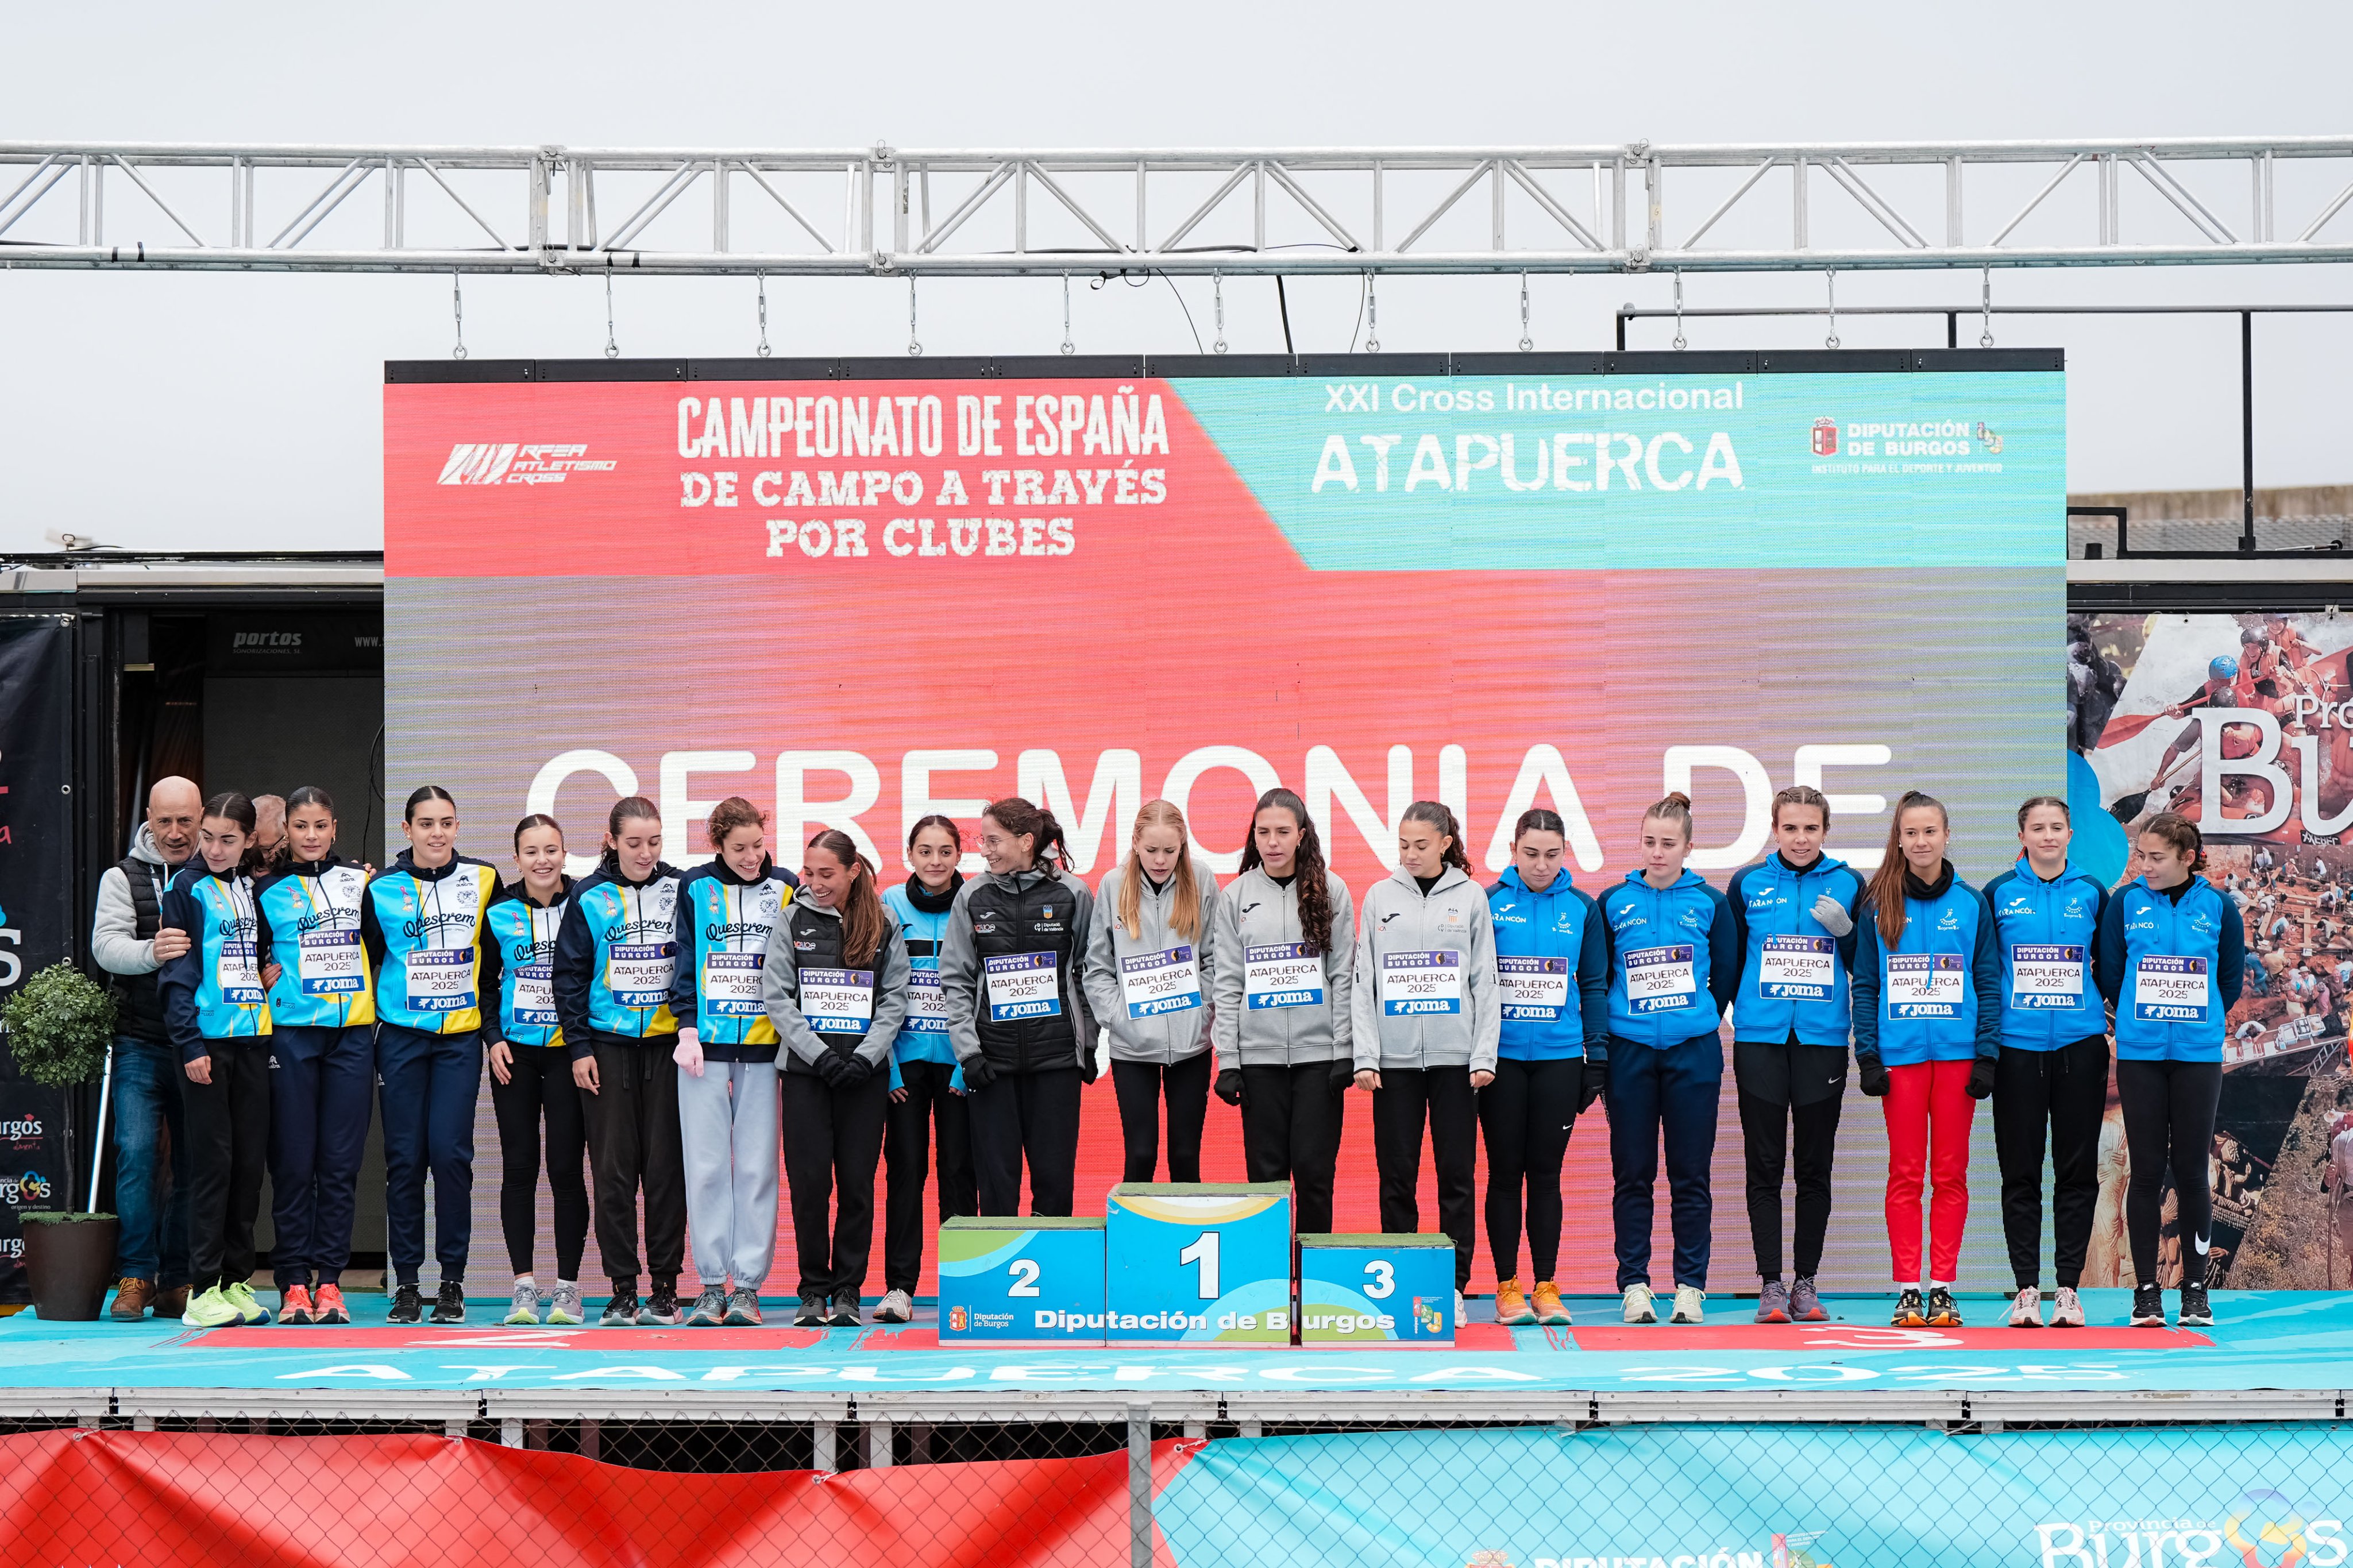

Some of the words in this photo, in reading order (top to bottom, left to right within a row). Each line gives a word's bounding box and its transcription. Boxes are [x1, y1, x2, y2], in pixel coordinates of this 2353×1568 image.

[1325, 384, 1378, 412] XXI
[1392, 383, 1494, 411] Cross
[1507, 382, 1743, 410] Internacional
[677, 395, 943, 458] CAMPEONATO
[957, 395, 1002, 455] DE
[1015, 385, 1170, 455] ESPAÑA
[1847, 419, 1969, 438] DIPUTACIÓN
[1847, 442, 1875, 455] DE
[1885, 441, 1970, 455] BURGOS
[514, 461, 617, 471] ATLETISMO
[1311, 432, 1745, 493] ATAPUERCA
[506, 473, 567, 484] CROSS
[681, 471, 738, 507] DE
[752, 470, 924, 507] CAMPO
[936, 470, 969, 505] A
[983, 459, 1167, 505] TRAVÉS
[766, 519, 869, 557] POR
[882, 517, 1075, 556] CLUBES
[233, 631, 302, 648] portos
[524, 743, 1605, 873] CEREMONIA
[1664, 744, 1893, 870] DE
[1749, 897, 1787, 907] TARANÓN
[298, 905, 360, 931] Quescrem
[403, 912, 476, 938] Quescrem
[304, 931, 345, 940] DIPUTACIÓN
[304, 937, 345, 945] BURGOS
[1249, 945, 1291, 954] DIPUTACIÓN
[1627, 949, 1666, 960] DIPUTACIÓN
[304, 952, 360, 963] ATAPUERCA
[989, 955, 1029, 966] DIPUTACIÓN
[1125, 952, 1166, 965] DIPUTACIÓN
[1249, 952, 1291, 960] BURGOS
[1388, 952, 1430, 961] DIPUTACIÓN
[1629, 955, 1666, 966] BURGOS
[325, 961, 350, 971] 2025
[989, 962, 1029, 971] BURGOS
[1126, 959, 1167, 971] BURGOS
[1765, 958, 1830, 968] ATAPUERCA
[614, 963, 673, 975] ATAPUERCA
[1250, 964, 1317, 977] ATAPUERCA
[1783, 968, 1812, 977] 2025
[2017, 968, 2080, 978] ATAPUERCA
[411, 970, 470, 980] ATAPUERCA
[633, 976, 661, 984] 2025
[1128, 968, 1192, 988] ATAPUERCA
[1270, 975, 1299, 986] 2025
[1387, 974, 1456, 983] ATAPUERCA
[1630, 969, 1689, 983] ATAPUERCA
[431, 982, 459, 990] 2025
[991, 975, 1054, 989] ATAPUERCA
[1149, 981, 1177, 994] 2025
[1499, 979, 1563, 990] ATAPUERCA
[1646, 980, 1675, 991] 2025
[1892, 978, 1959, 987] ATAPUERCA
[2035, 978, 2064, 987] 2025
[2140, 978, 2204, 990] ATAPUERCA
[519, 984, 553, 994] ATAPU
[730, 985, 757, 994] 2025
[1009, 986, 1037, 997] 2025
[1407, 984, 1436, 993] 2025
[1911, 987, 1941, 996] 2025
[2159, 989, 2188, 999] 2025
[804, 991, 868, 1002] ATAPUERCA
[1515, 990, 1544, 999] 2025
[820, 1001, 849, 1011] 2025
[1179, 1230, 1221, 1300] 1
[1007, 1258, 1041, 1298] 2
[1361, 1259, 1396, 1299] 3
[974, 1313, 1013, 1321] Diputación
[1035, 1310, 1208, 1334] Diputación
[1217, 1310, 1259, 1331] de
[2089, 1517, 2192, 1532] Provincia
[2197, 1519, 2216, 1529] de
